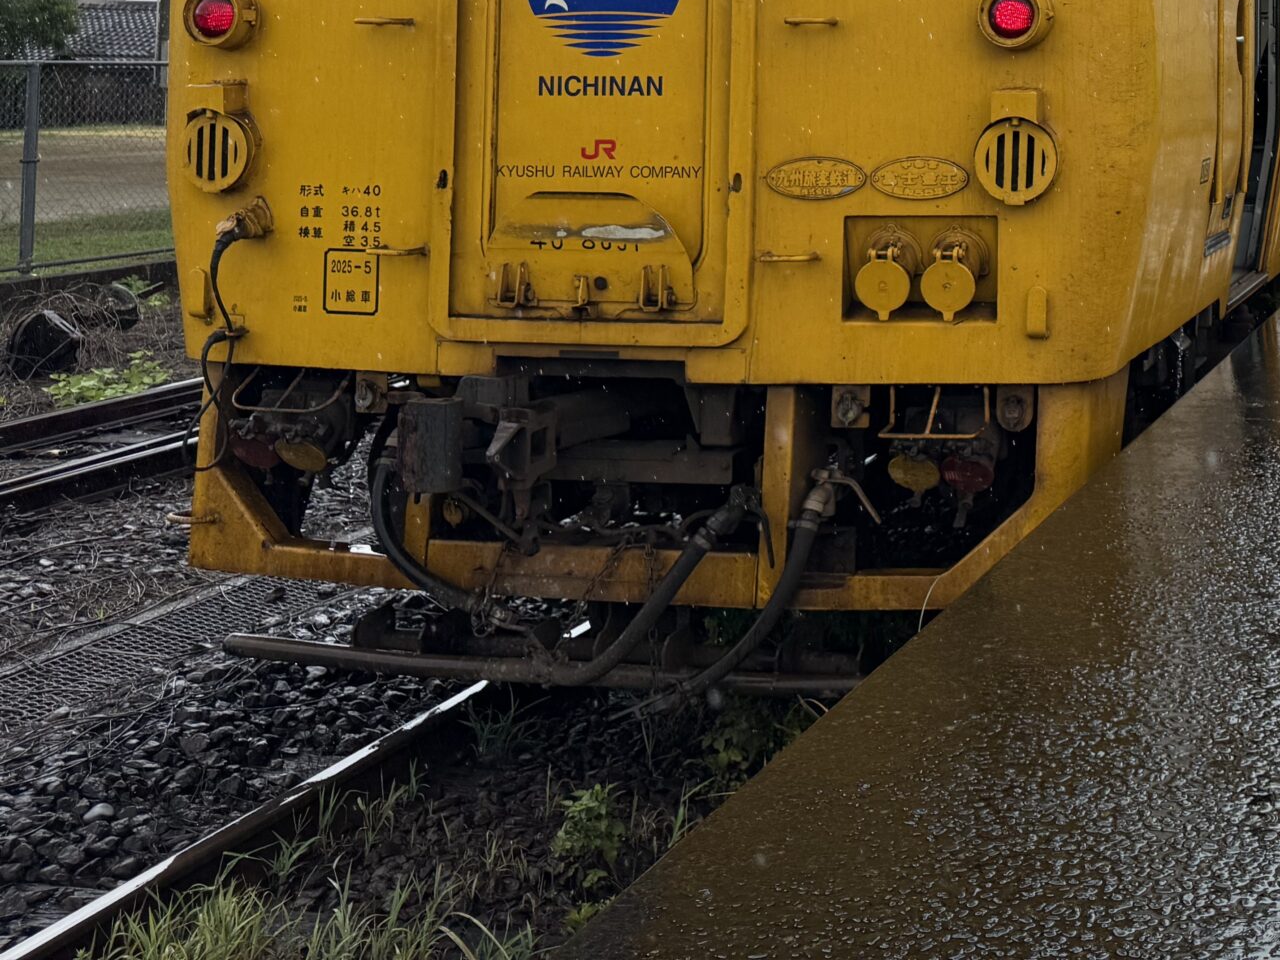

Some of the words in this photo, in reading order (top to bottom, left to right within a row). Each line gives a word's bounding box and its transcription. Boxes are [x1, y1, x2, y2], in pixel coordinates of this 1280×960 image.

[538, 75, 664, 97] NICHINAN
[580, 138, 617, 160] JR
[496, 164, 556, 178] KYUSHU
[562, 165, 624, 178] RAILWAY
[630, 165, 702, 179] COMPANY
[299, 183, 325, 197] 形式
[299, 205, 324, 218] 自重
[341, 205, 381, 218] 36.8t
